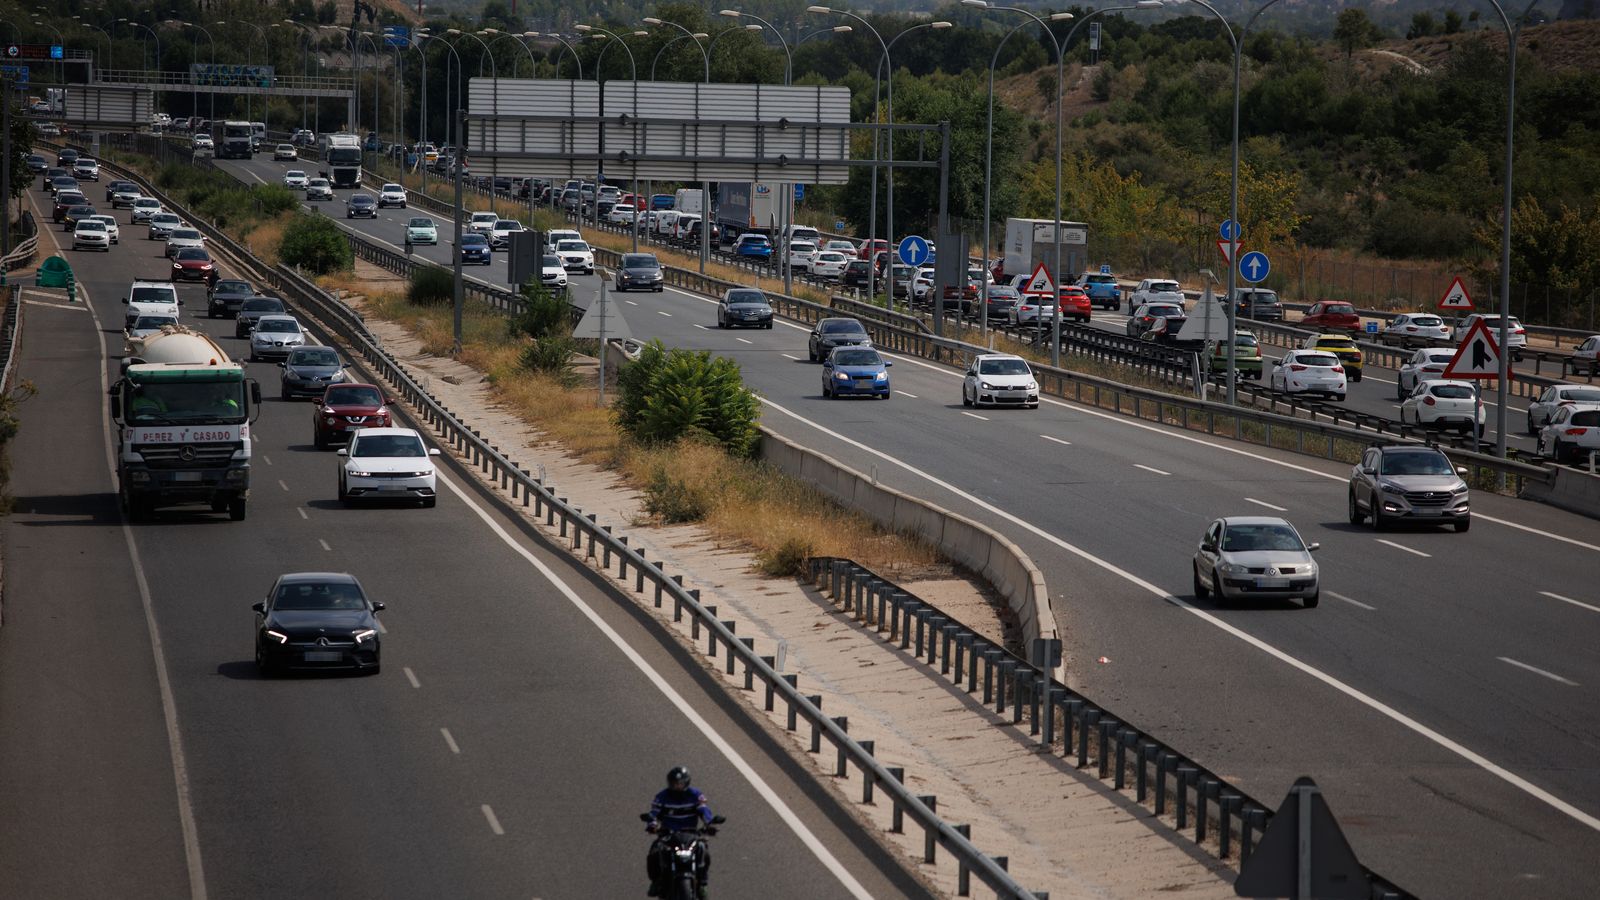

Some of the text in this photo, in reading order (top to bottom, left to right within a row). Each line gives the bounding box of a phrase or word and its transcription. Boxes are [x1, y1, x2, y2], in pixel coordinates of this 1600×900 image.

[143, 431, 231, 442] PEREZ Y CASADO
[240, 426, 248, 437] 47
